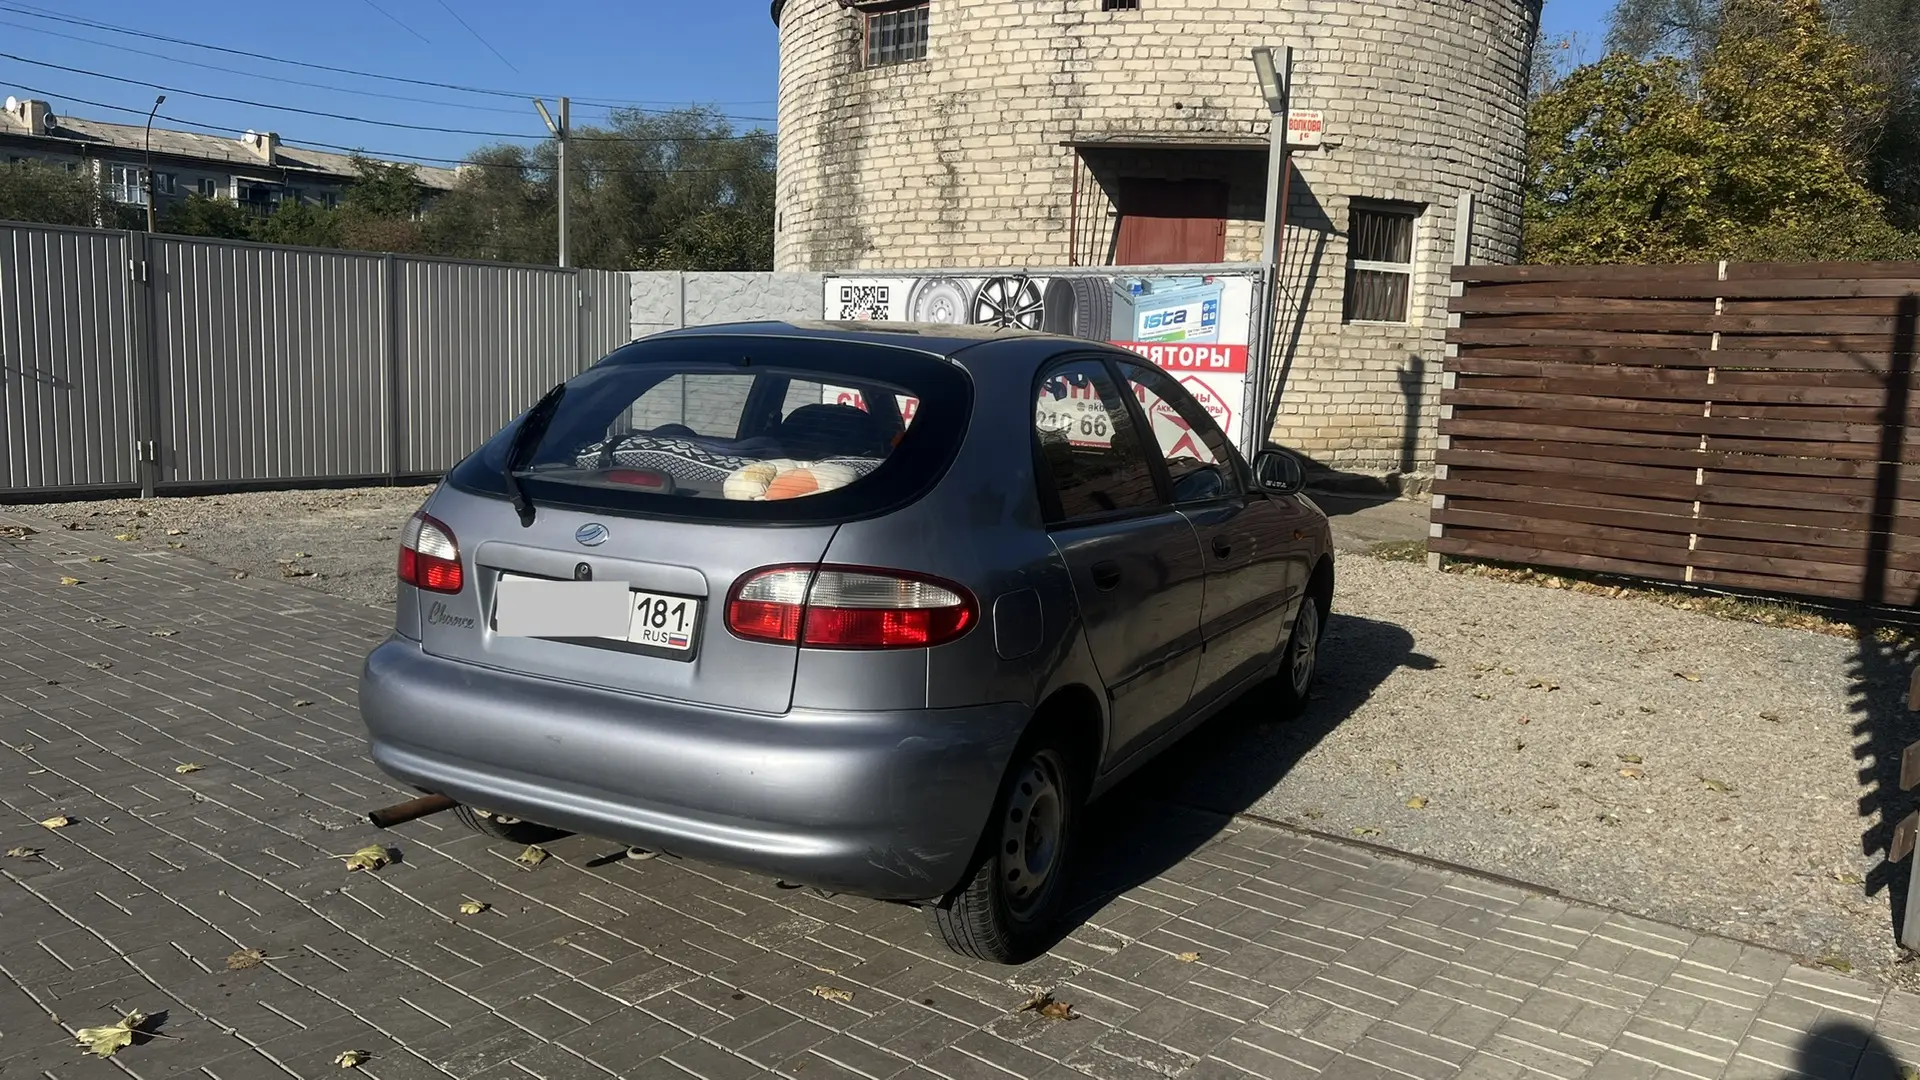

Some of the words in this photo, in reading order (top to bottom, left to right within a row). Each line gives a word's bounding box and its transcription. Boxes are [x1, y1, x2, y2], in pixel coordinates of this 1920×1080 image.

[1289, 119, 1321, 132] ВОЛКОВА
[1081, 414, 1107, 437] 66
[637, 597, 686, 632] 181
[643, 629, 669, 643] RUS
